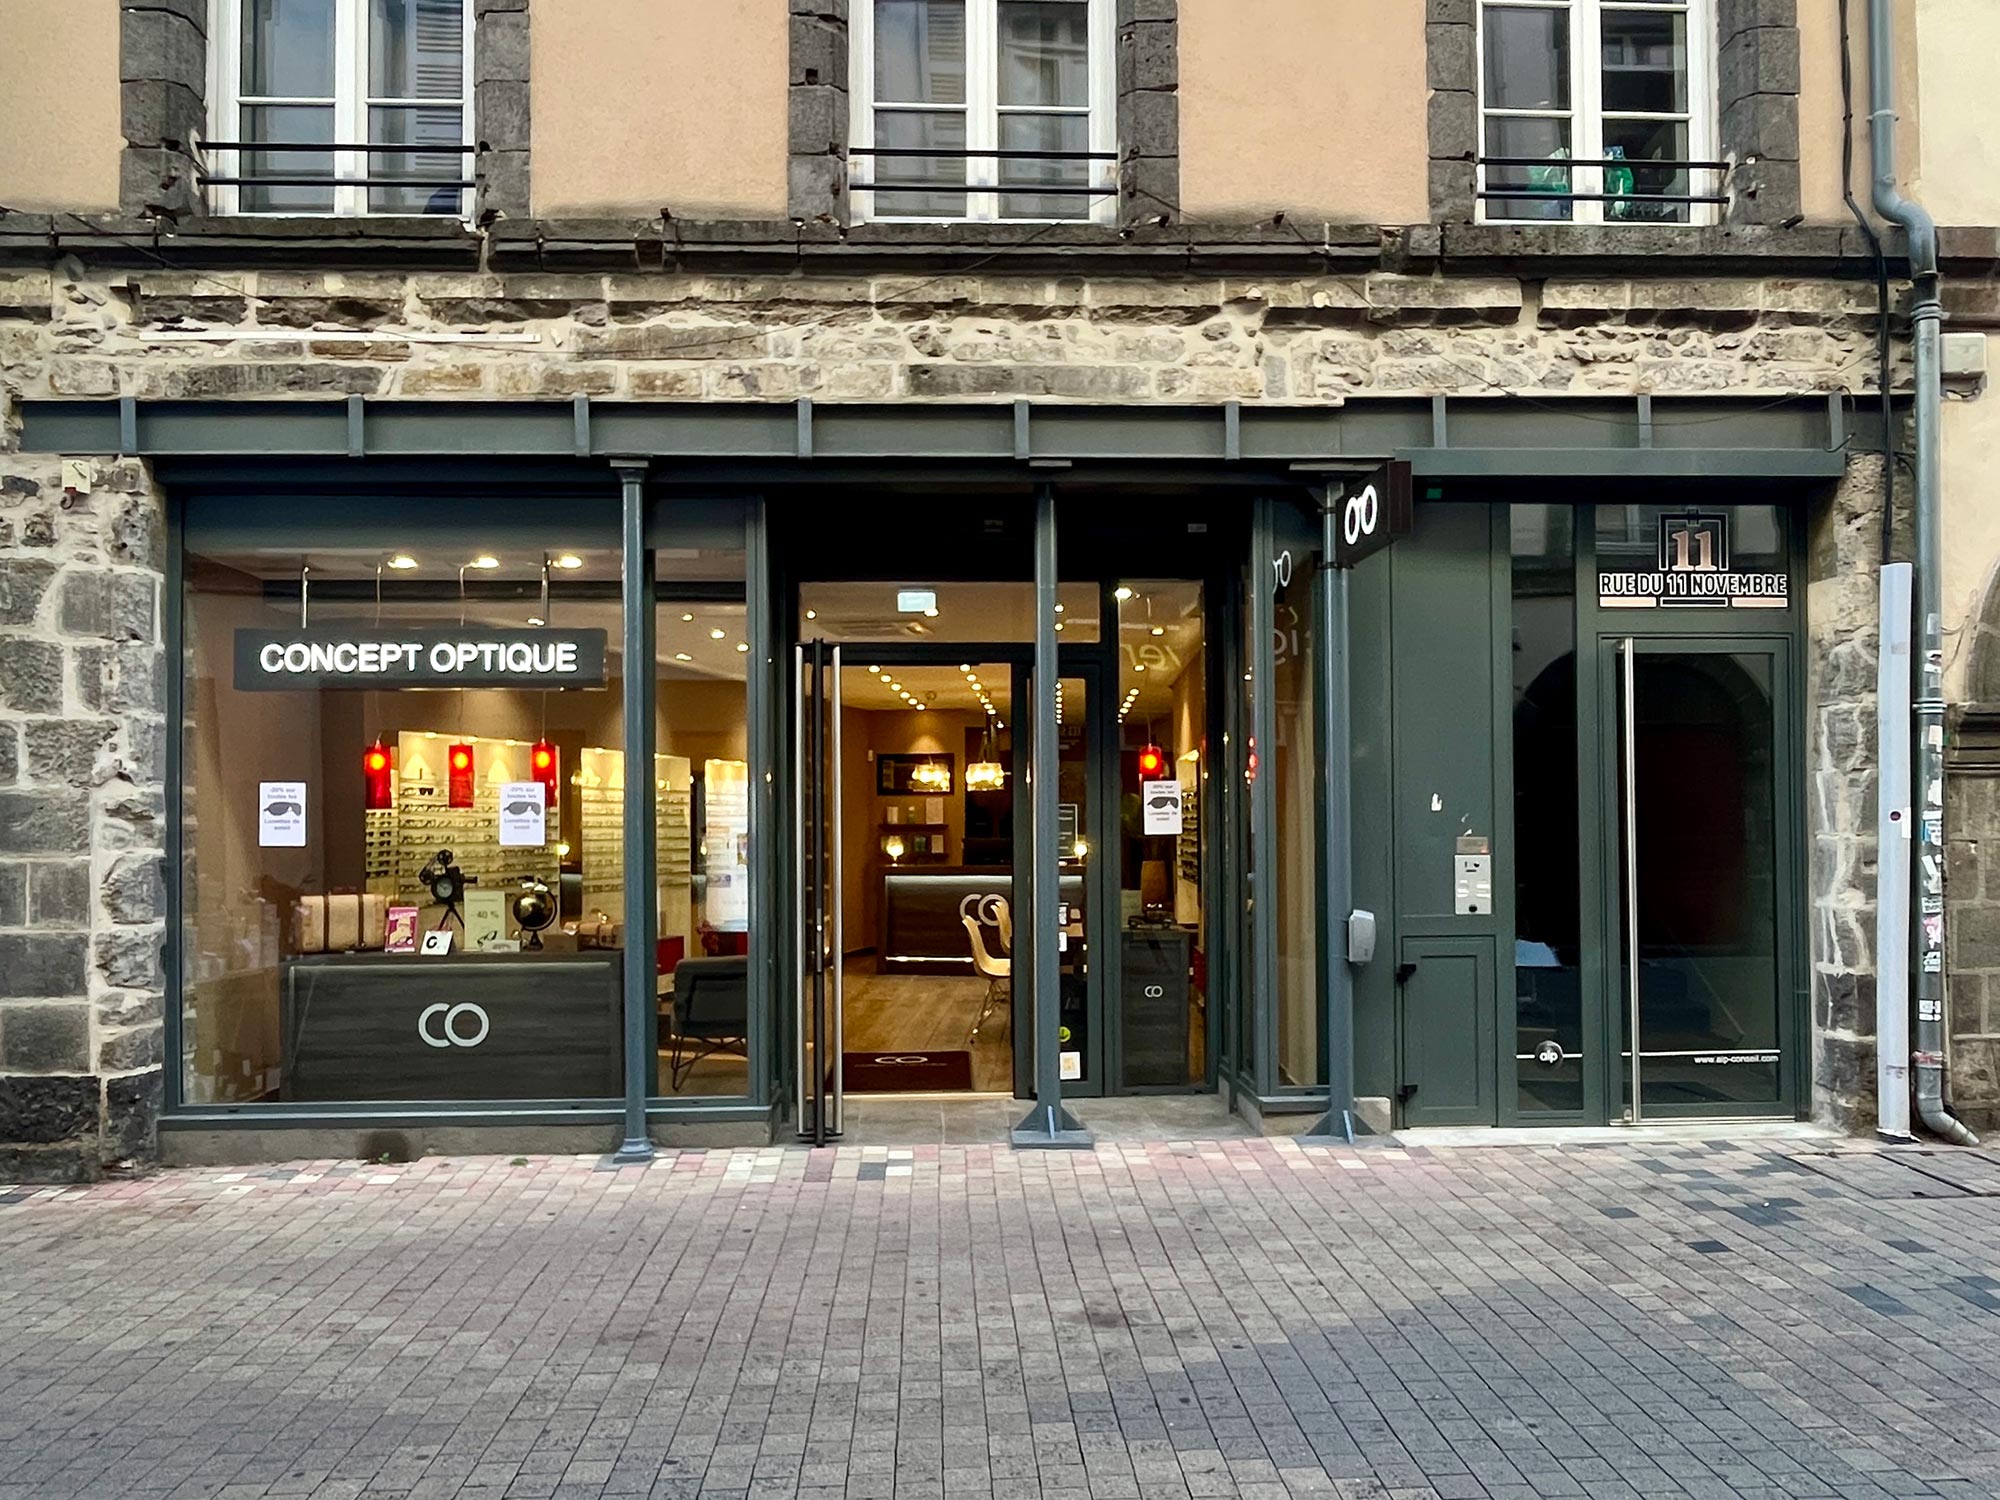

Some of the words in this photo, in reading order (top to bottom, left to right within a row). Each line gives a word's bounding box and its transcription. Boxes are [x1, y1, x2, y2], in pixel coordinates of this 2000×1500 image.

[1671, 530, 1717, 571] 11
[1600, 573, 1635, 595] RUE
[1638, 573, 1663, 595] DU
[1667, 574, 1687, 595] 11
[1691, 574, 1787, 595] NOVEMBRE
[259, 643, 423, 673] CONCEPT
[430, 643, 578, 674] OPTIQUE
[1144, 985, 1163, 998] CO
[418, 1002, 490, 1048] CO
